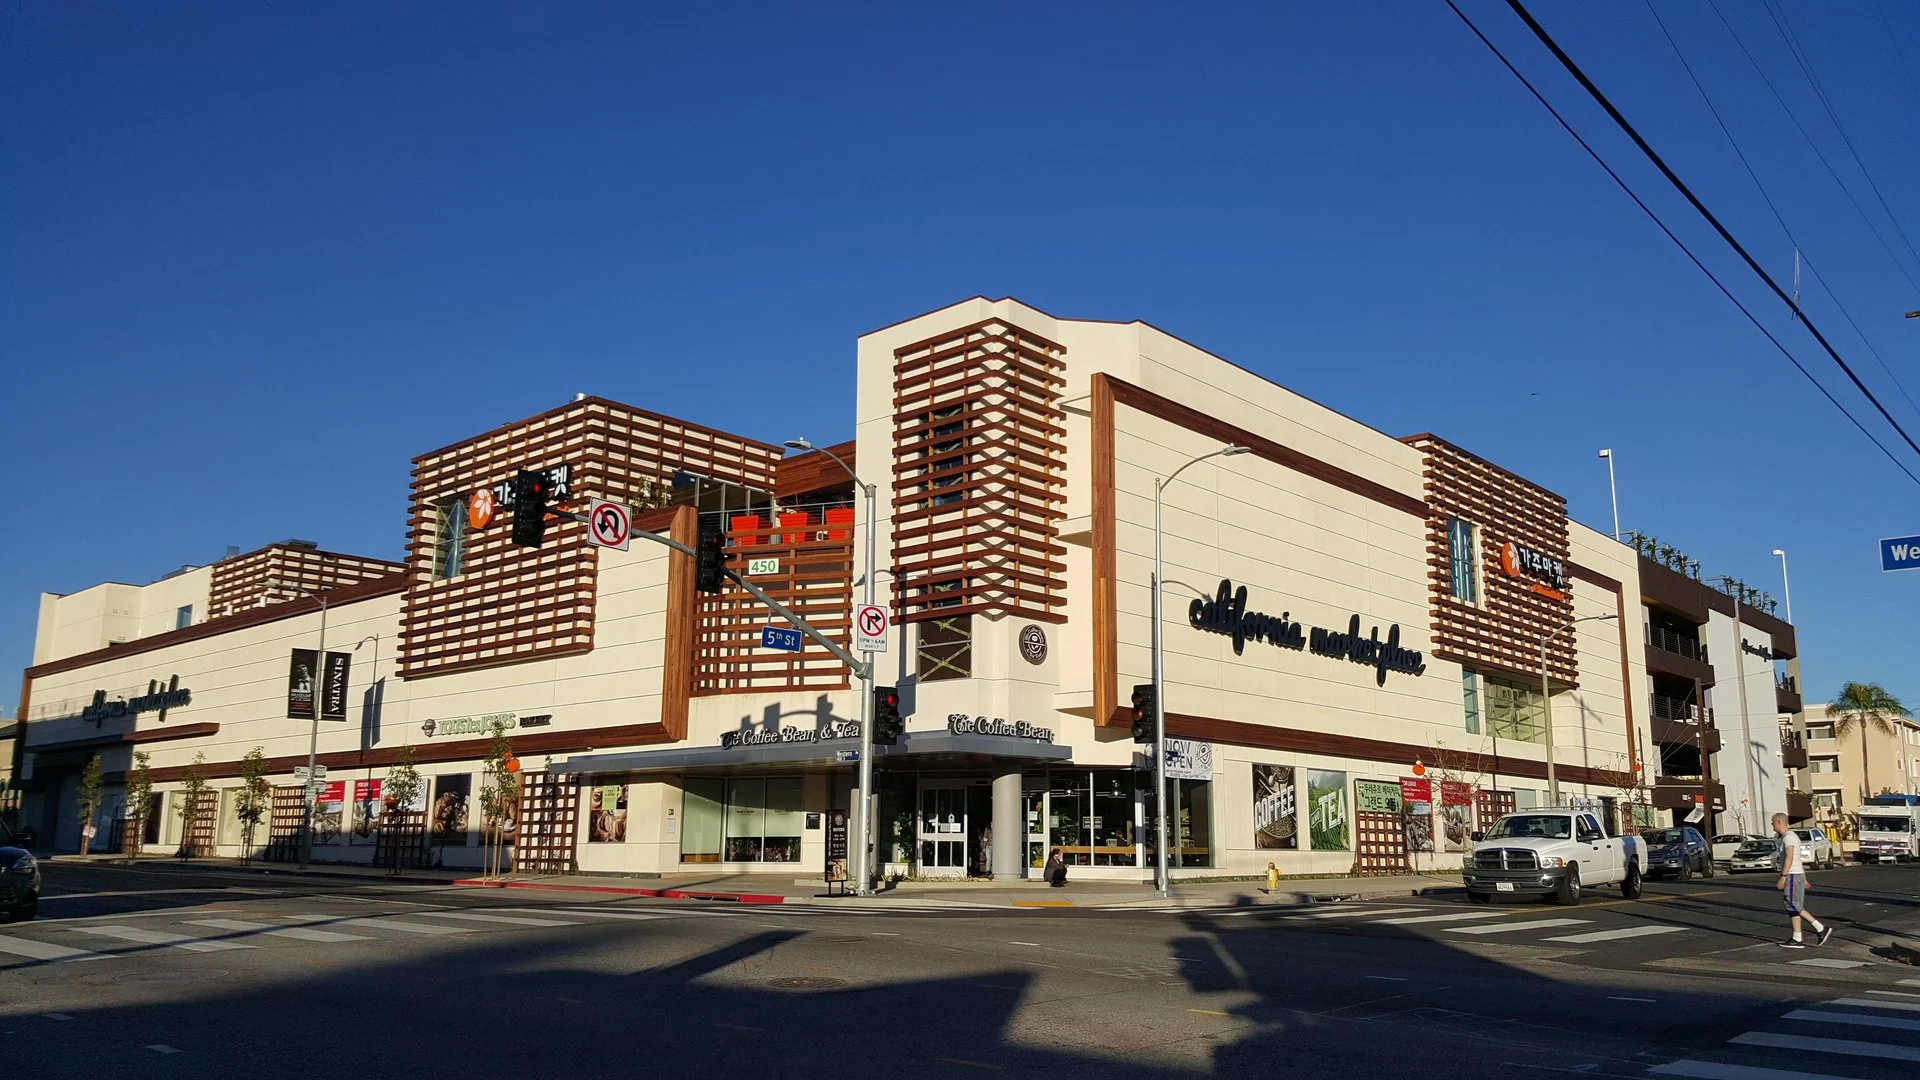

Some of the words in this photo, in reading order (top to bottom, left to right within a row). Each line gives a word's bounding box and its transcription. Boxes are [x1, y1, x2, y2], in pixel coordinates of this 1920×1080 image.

[493, 464, 569, 506] 가켓
[751, 560, 776, 573] 450
[1519, 547, 1563, 586] 가주마켓
[1890, 543, 1920, 561] We
[767, 631, 783, 645] 5th
[784, 636, 796, 647] St
[1188, 578, 1307, 656] california
[1309, 613, 1426, 688] marketplace
[331, 657, 344, 713] SINATRA
[742, 729, 778, 745] Coffee
[820, 723, 832, 739] &
[836, 721, 860, 738] Tea
[948, 714, 975, 735] The
[976, 716, 1018, 736] Coffee
[1165, 740, 1191, 754] NOW
[1254, 784, 1295, 831] COFFEE
[1318, 788, 1346, 832] TEA
